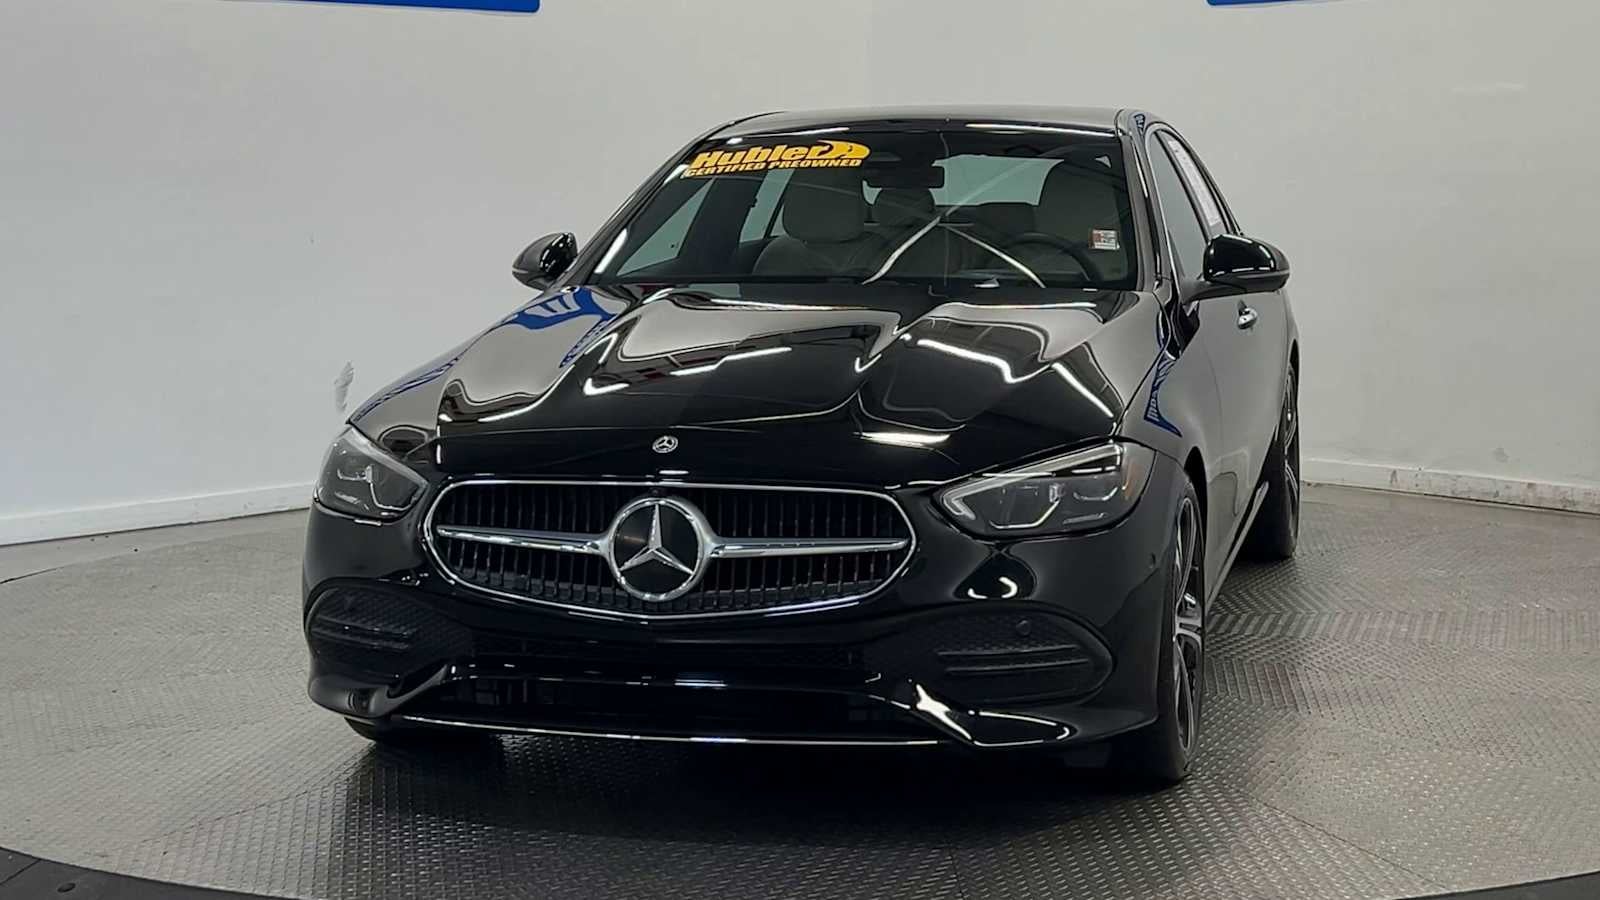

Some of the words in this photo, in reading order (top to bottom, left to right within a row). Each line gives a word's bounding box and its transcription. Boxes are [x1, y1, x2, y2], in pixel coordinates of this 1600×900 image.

[689, 143, 836, 169] Hubler
[682, 162, 765, 179] CERTIFIED
[768, 158, 862, 169] PREOWNED
